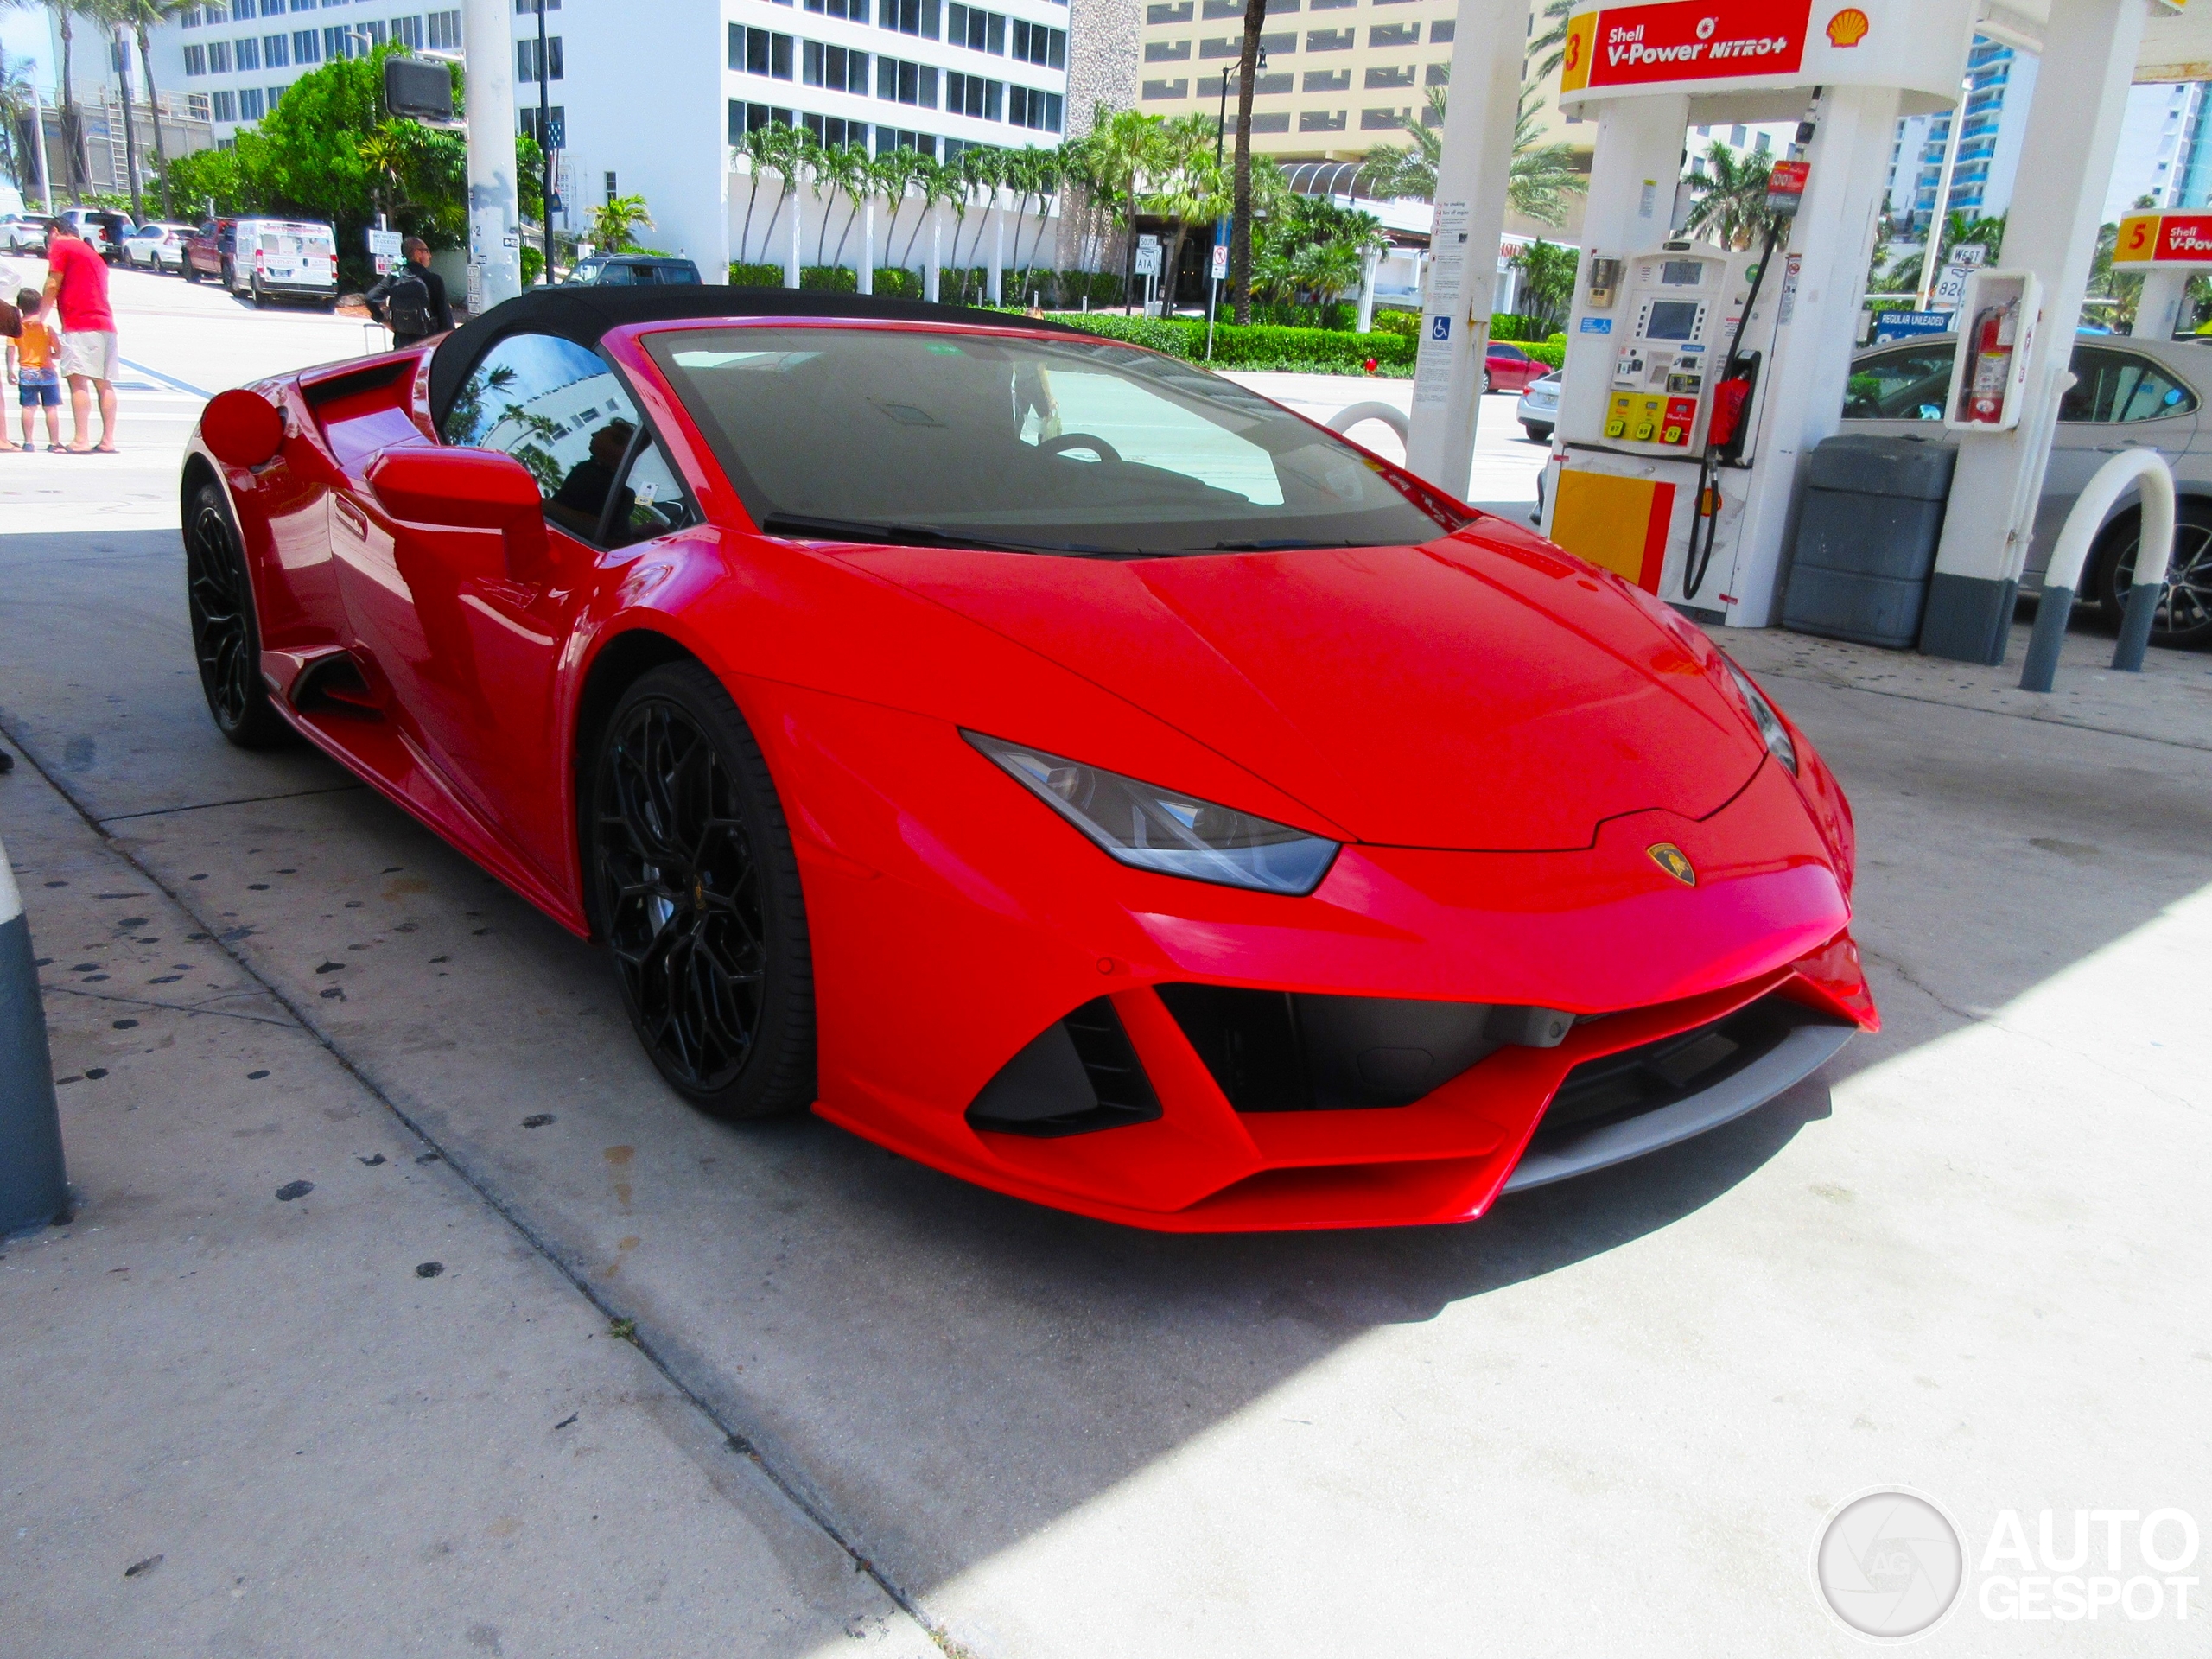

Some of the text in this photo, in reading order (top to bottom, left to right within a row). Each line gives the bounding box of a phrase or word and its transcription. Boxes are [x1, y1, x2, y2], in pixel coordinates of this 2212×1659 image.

[1608, 24, 1645, 43] Shell
[1565, 34, 1580, 71] 3
[1607, 43, 1704, 67] V-Power
[2128, 223, 2147, 250] 5
[2170, 226, 2197, 237] Shell
[1954, 249, 1980, 261] WEST
[1882, 314, 1945, 327] REGULAR UNLEADED
